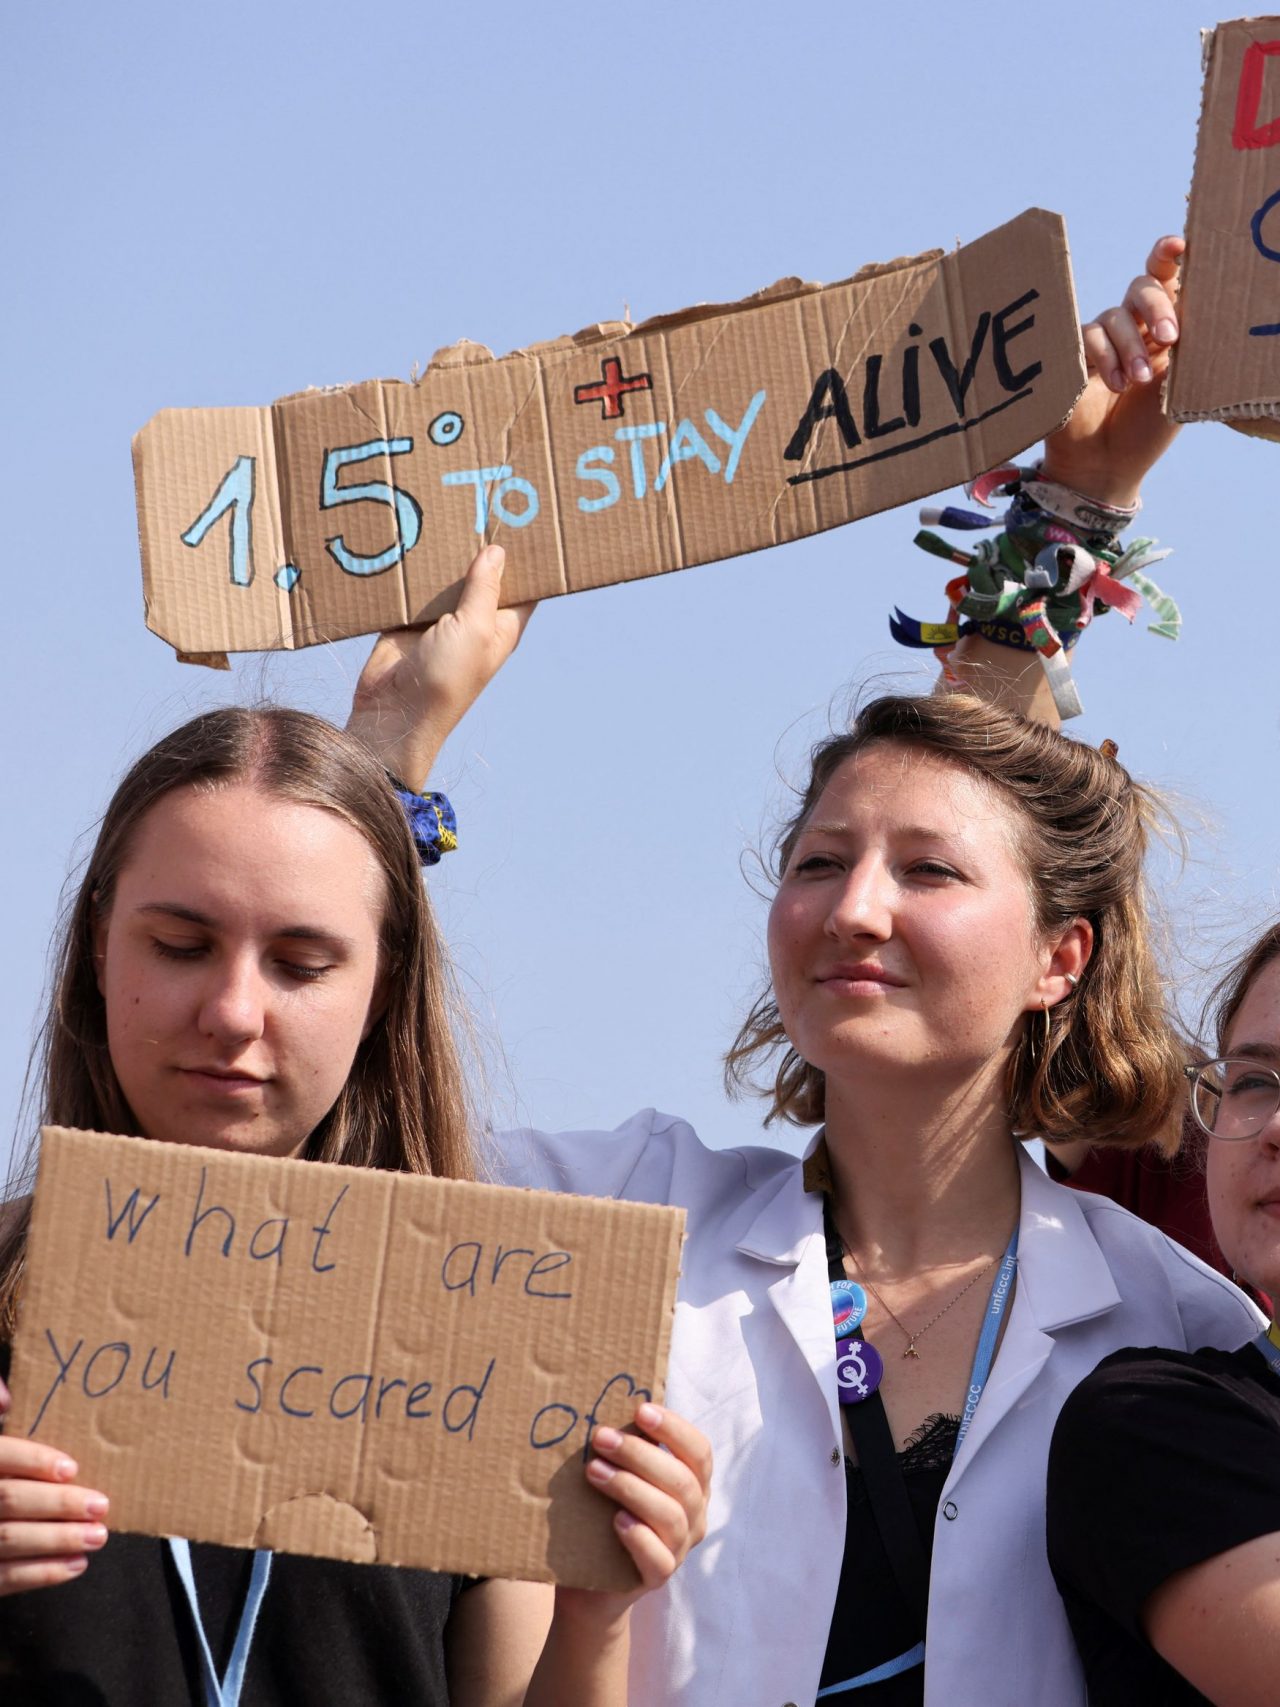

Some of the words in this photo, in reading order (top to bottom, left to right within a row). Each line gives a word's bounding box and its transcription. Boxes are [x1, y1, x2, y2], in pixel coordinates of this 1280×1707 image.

[576, 389, 766, 513] STAY
[441, 1241, 573, 1299] are
[836, 1306, 863, 1334] FUTURE
[27, 1327, 177, 1437] you
[234, 1357, 497, 1442] scared
[529, 1372, 652, 1464] of
